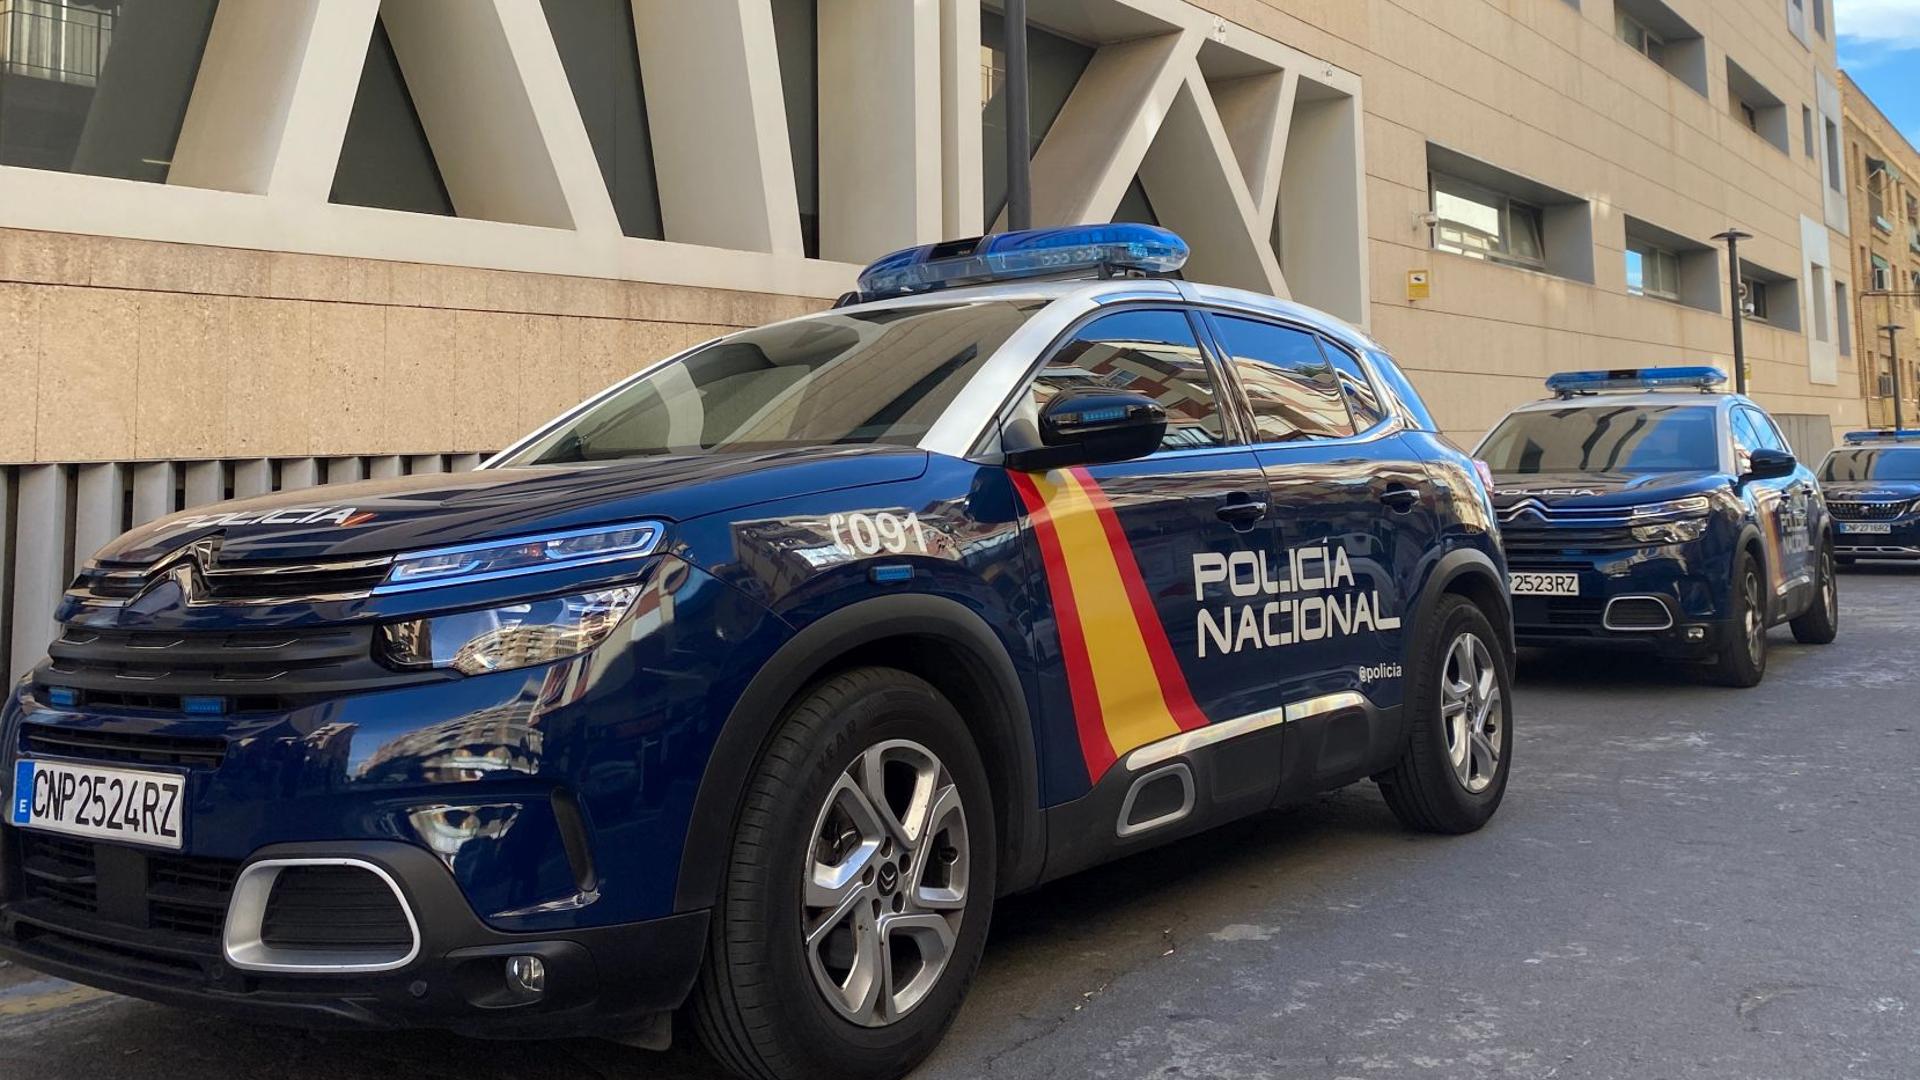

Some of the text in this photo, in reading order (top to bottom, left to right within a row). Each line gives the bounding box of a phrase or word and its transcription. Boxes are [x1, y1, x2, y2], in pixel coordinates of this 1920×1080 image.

[1192, 536, 1355, 601] POLICÍA
[1197, 590, 1401, 658] NACIONAL
[1359, 662, 1403, 683] @policia
[19, 799, 28, 813] E
